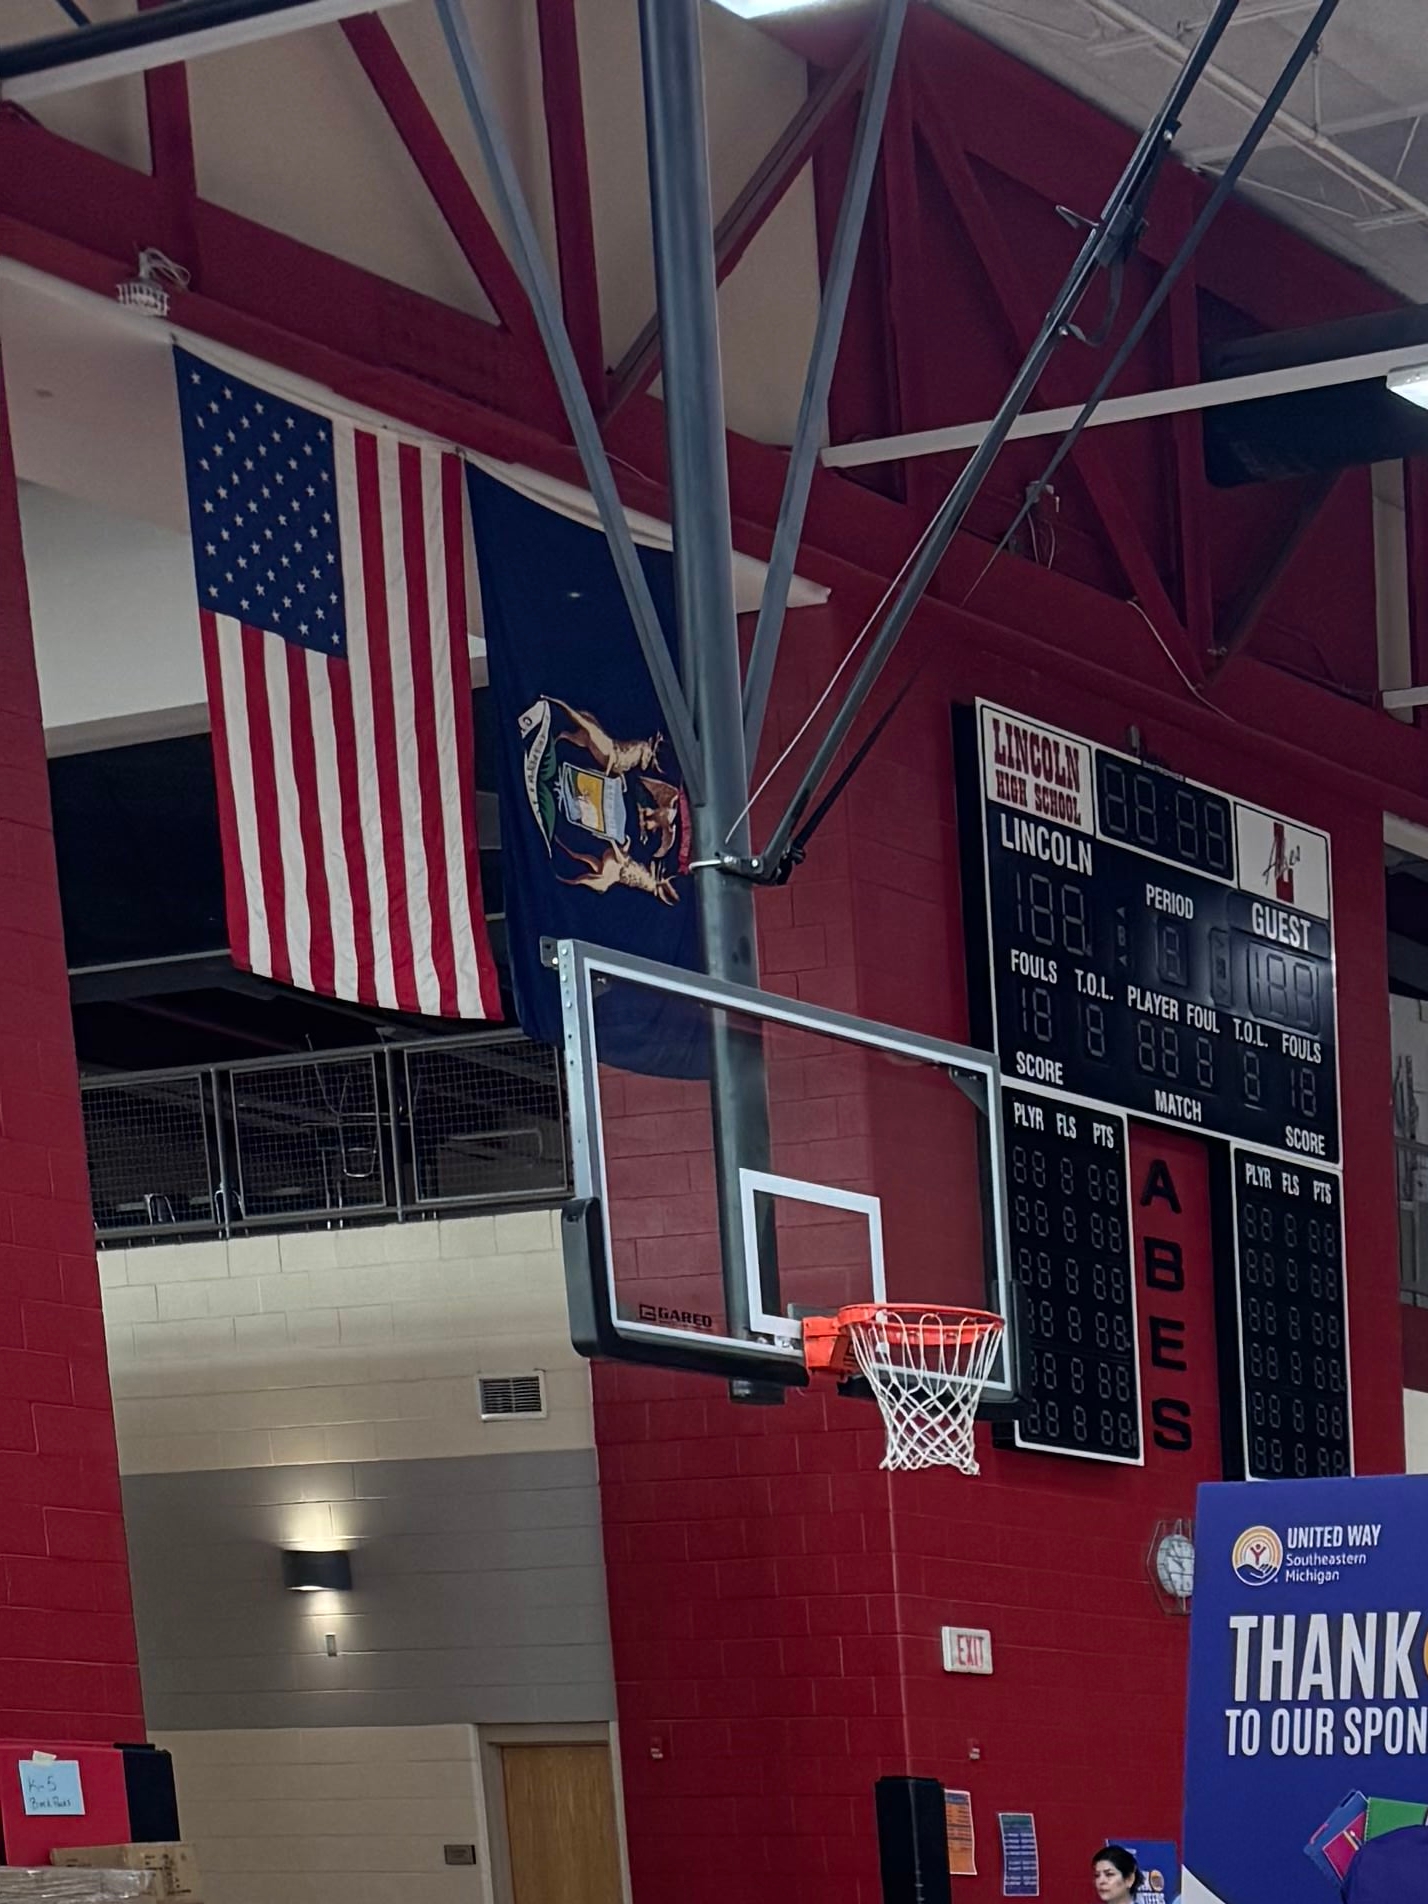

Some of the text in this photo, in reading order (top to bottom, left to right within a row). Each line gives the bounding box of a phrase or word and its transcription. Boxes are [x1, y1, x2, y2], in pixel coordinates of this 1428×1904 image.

[992, 718, 1081, 794] LINCOLN
[996, 770, 1082, 826] HIGH SCHOOL
[1000, 813, 1093, 876] LINCOLN
[1146, 883, 1194, 920] PERIOD
[1252, 902, 1312, 950] GUEST
[1011, 949, 1322, 1064] FOULS T.O.L. PLAYER FOUL T.O.L. FOULS
[1013, 1102, 1115, 1149] PLYR FLS PTS
[1016, 1051, 1326, 1156] SCORE MATCH SCORE
[1245, 1162, 1332, 1205] PLYR FLS PTS
[658, 1307, 712, 1328] GARED
[1140, 1159, 1192, 1452] ABES
[1286, 1552, 1366, 1567] Southeastern
[1287, 1524, 1381, 1549] UNITED WAY
[1285, 1569, 1340, 1584] Michigan
[957, 1634, 984, 1668] EXIT
[1229, 1611, 1422, 1702] THANK
[1225, 1708, 1261, 1756] TO
[1271, 1708, 1334, 1756] OUR
